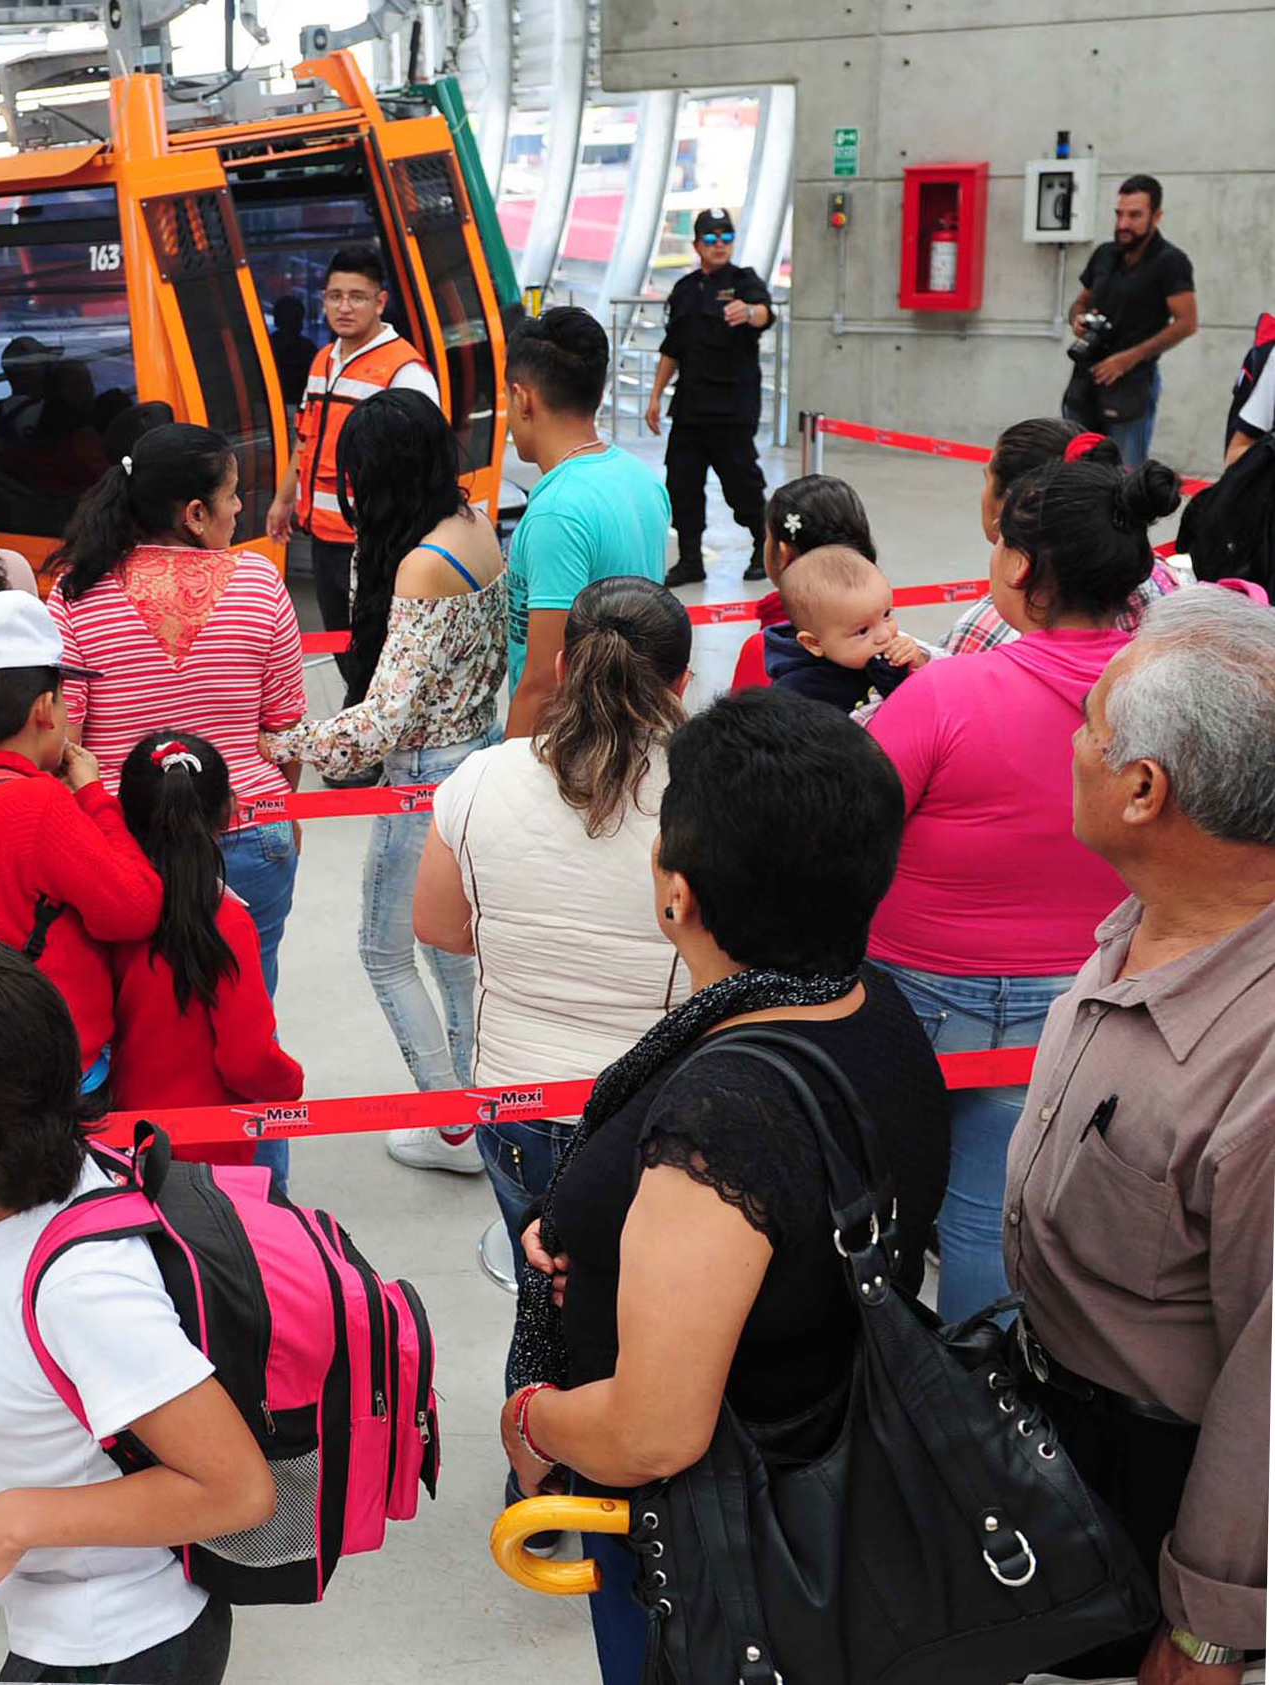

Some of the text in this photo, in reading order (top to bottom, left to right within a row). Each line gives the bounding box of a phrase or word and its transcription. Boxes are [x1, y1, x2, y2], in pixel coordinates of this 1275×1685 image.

[89, 244, 120, 271] 163
[501, 1088, 542, 1104] Mexi
[267, 1106, 307, 1120] Mexi
